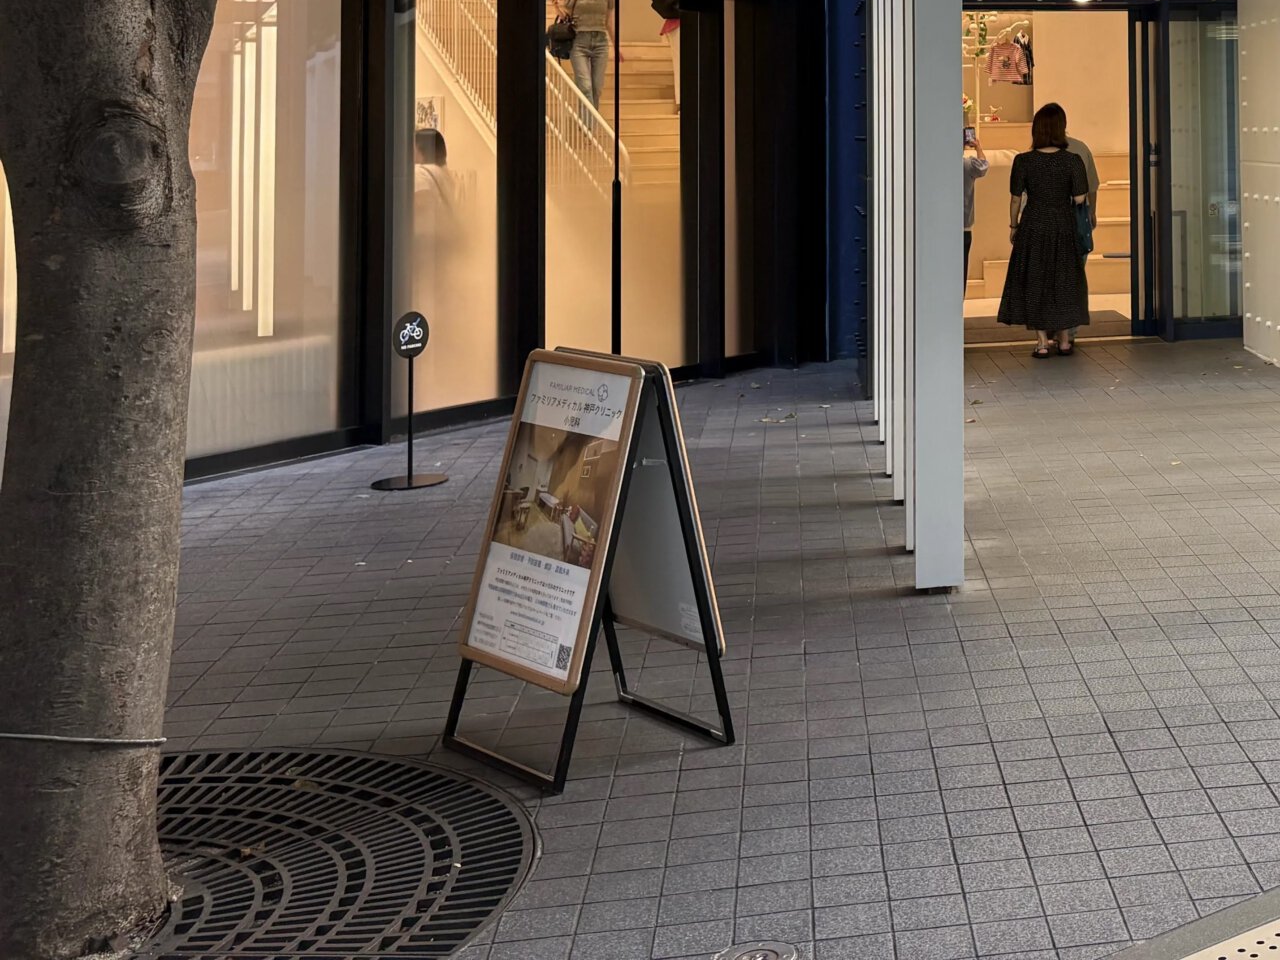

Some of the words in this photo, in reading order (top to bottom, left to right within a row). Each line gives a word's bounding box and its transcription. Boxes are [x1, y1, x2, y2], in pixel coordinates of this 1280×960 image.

[573, 386, 595, 397] MEDICAL
[530, 393, 582, 412] ファミリアメディカル
[583, 403, 622, 419] 神戸クリニック
[564, 416, 580, 427] 小児科
